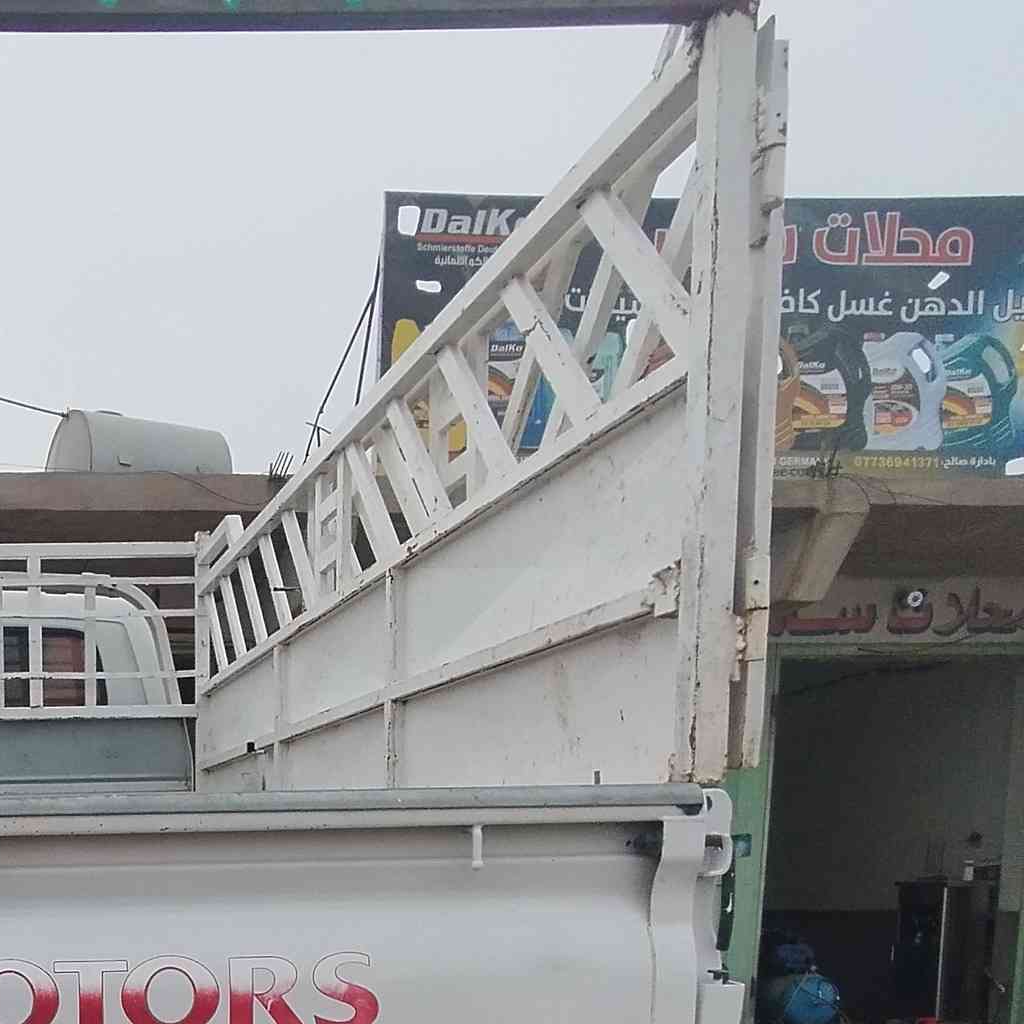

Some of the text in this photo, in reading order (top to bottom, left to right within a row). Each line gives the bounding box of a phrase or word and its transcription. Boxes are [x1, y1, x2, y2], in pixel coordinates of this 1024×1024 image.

[812, 211, 975, 267] محلات
[779, 288, 821, 314] كاف
[827, 289, 893, 322] غسل
[900, 290, 984, 323] الدهن
